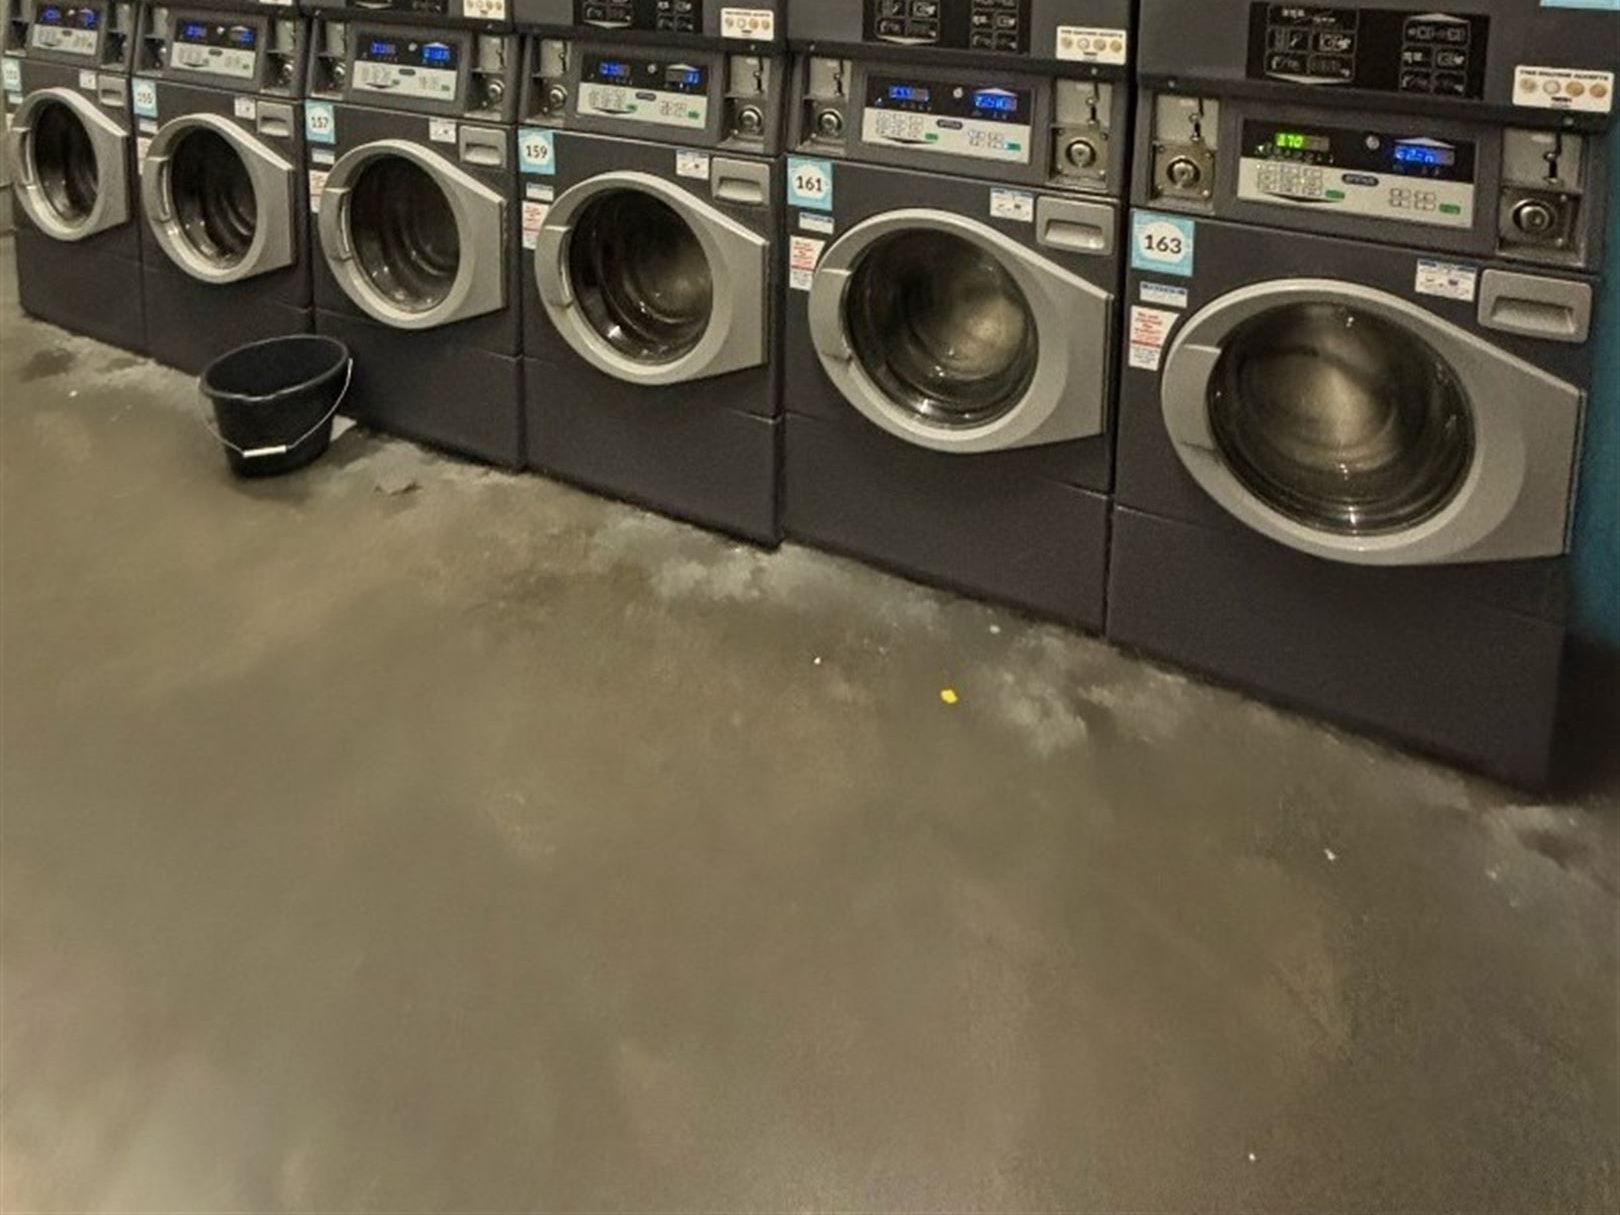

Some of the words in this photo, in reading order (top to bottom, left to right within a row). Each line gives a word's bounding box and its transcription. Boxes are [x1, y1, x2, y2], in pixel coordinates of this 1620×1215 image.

[310, 115, 329, 130] 157
[526, 143, 548, 160] 159
[795, 174, 823, 193] 161
[1144, 234, 1182, 255] 163
